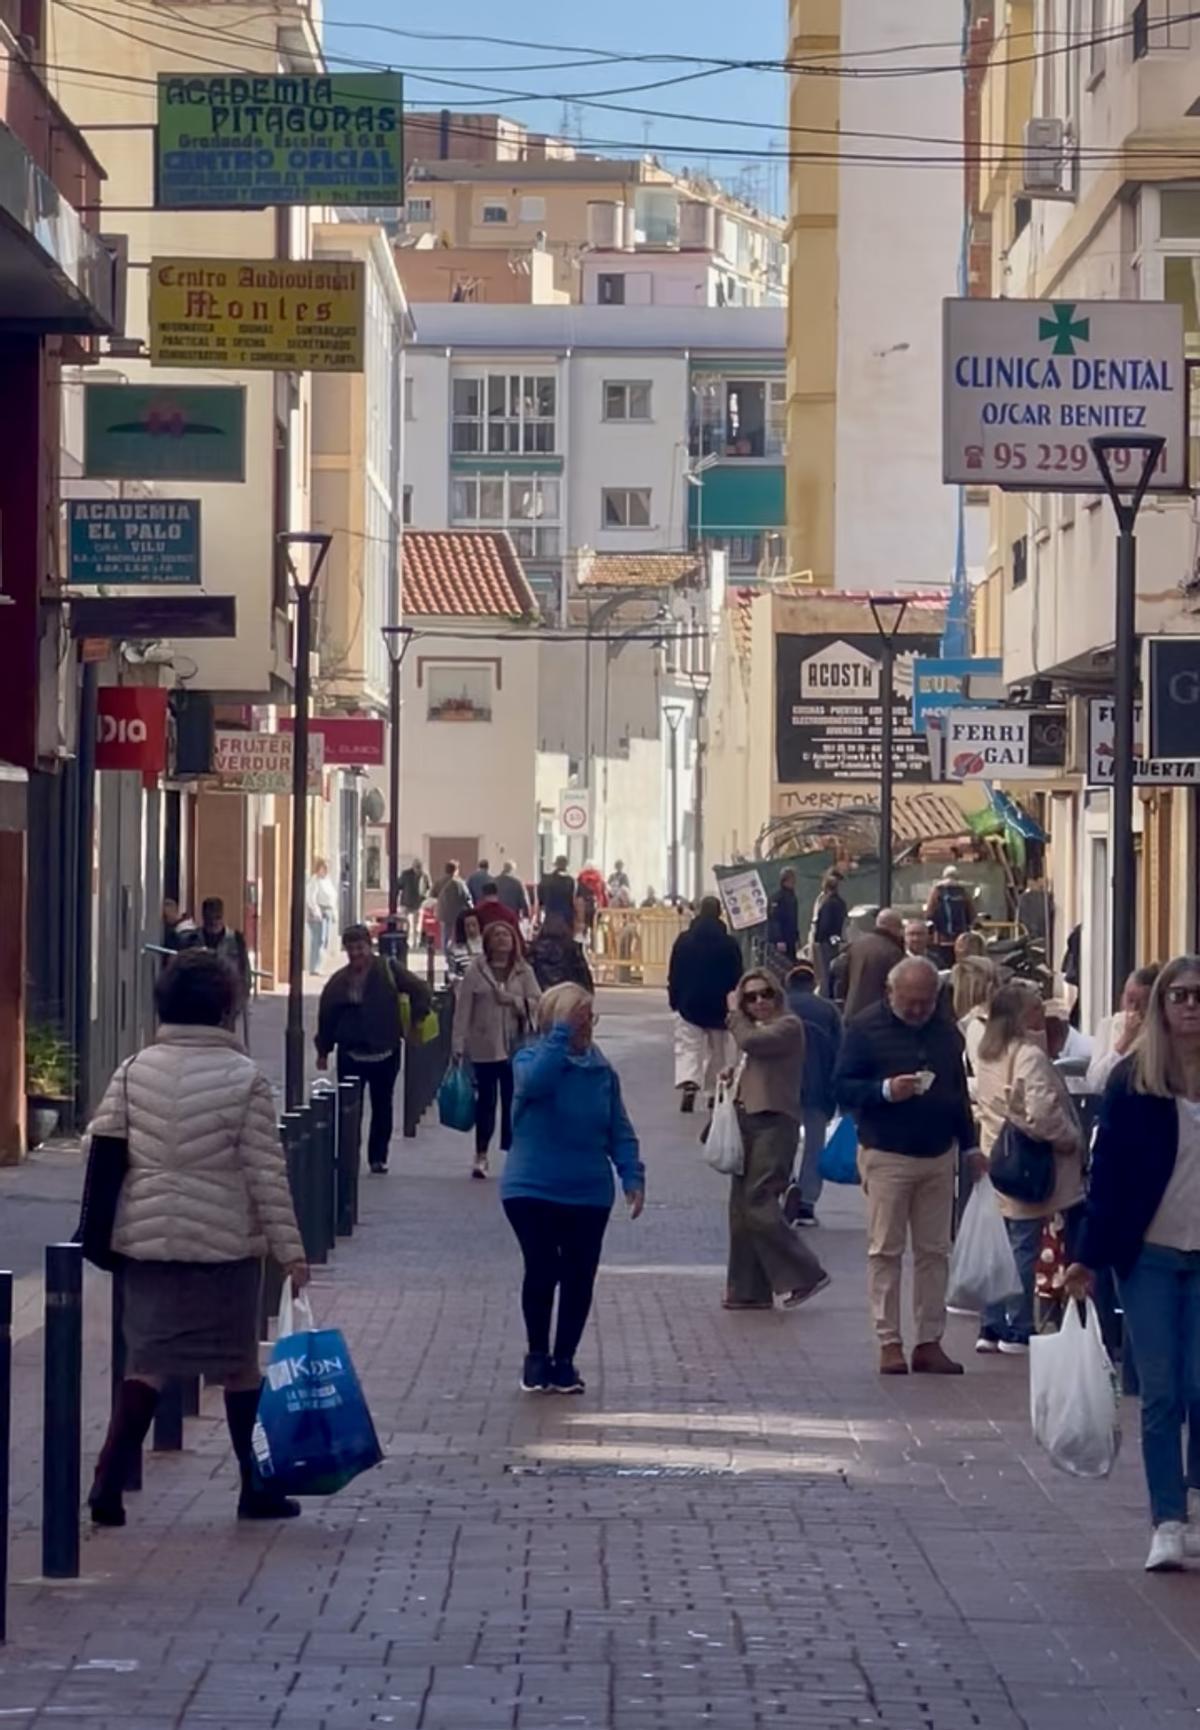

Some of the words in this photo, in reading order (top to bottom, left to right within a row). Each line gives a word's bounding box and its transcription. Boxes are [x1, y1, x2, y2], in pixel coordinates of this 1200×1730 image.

[166, 77, 332, 105] ACADEMIA
[211, 106, 396, 133] PITAGORAS
[288, 149, 395, 170] OFICIAL
[158, 265, 227, 288] Centro
[185, 290, 332, 321] Montes
[955, 356, 1062, 389] CLINICA
[1072, 358, 1174, 391] DENTAL
[982, 402, 1051, 426] OSCAR
[1060, 403, 1147, 428] BENITEZ
[993, 442, 1027, 470] 95
[1036, 443, 1089, 472] 229
[75, 504, 190, 519] ACADEMIA
[88, 523, 117, 540] EL
[125, 523, 181, 540] PALO
[808, 663, 872, 687] ACOSTA
[219, 738, 292, 754] FRUTER
